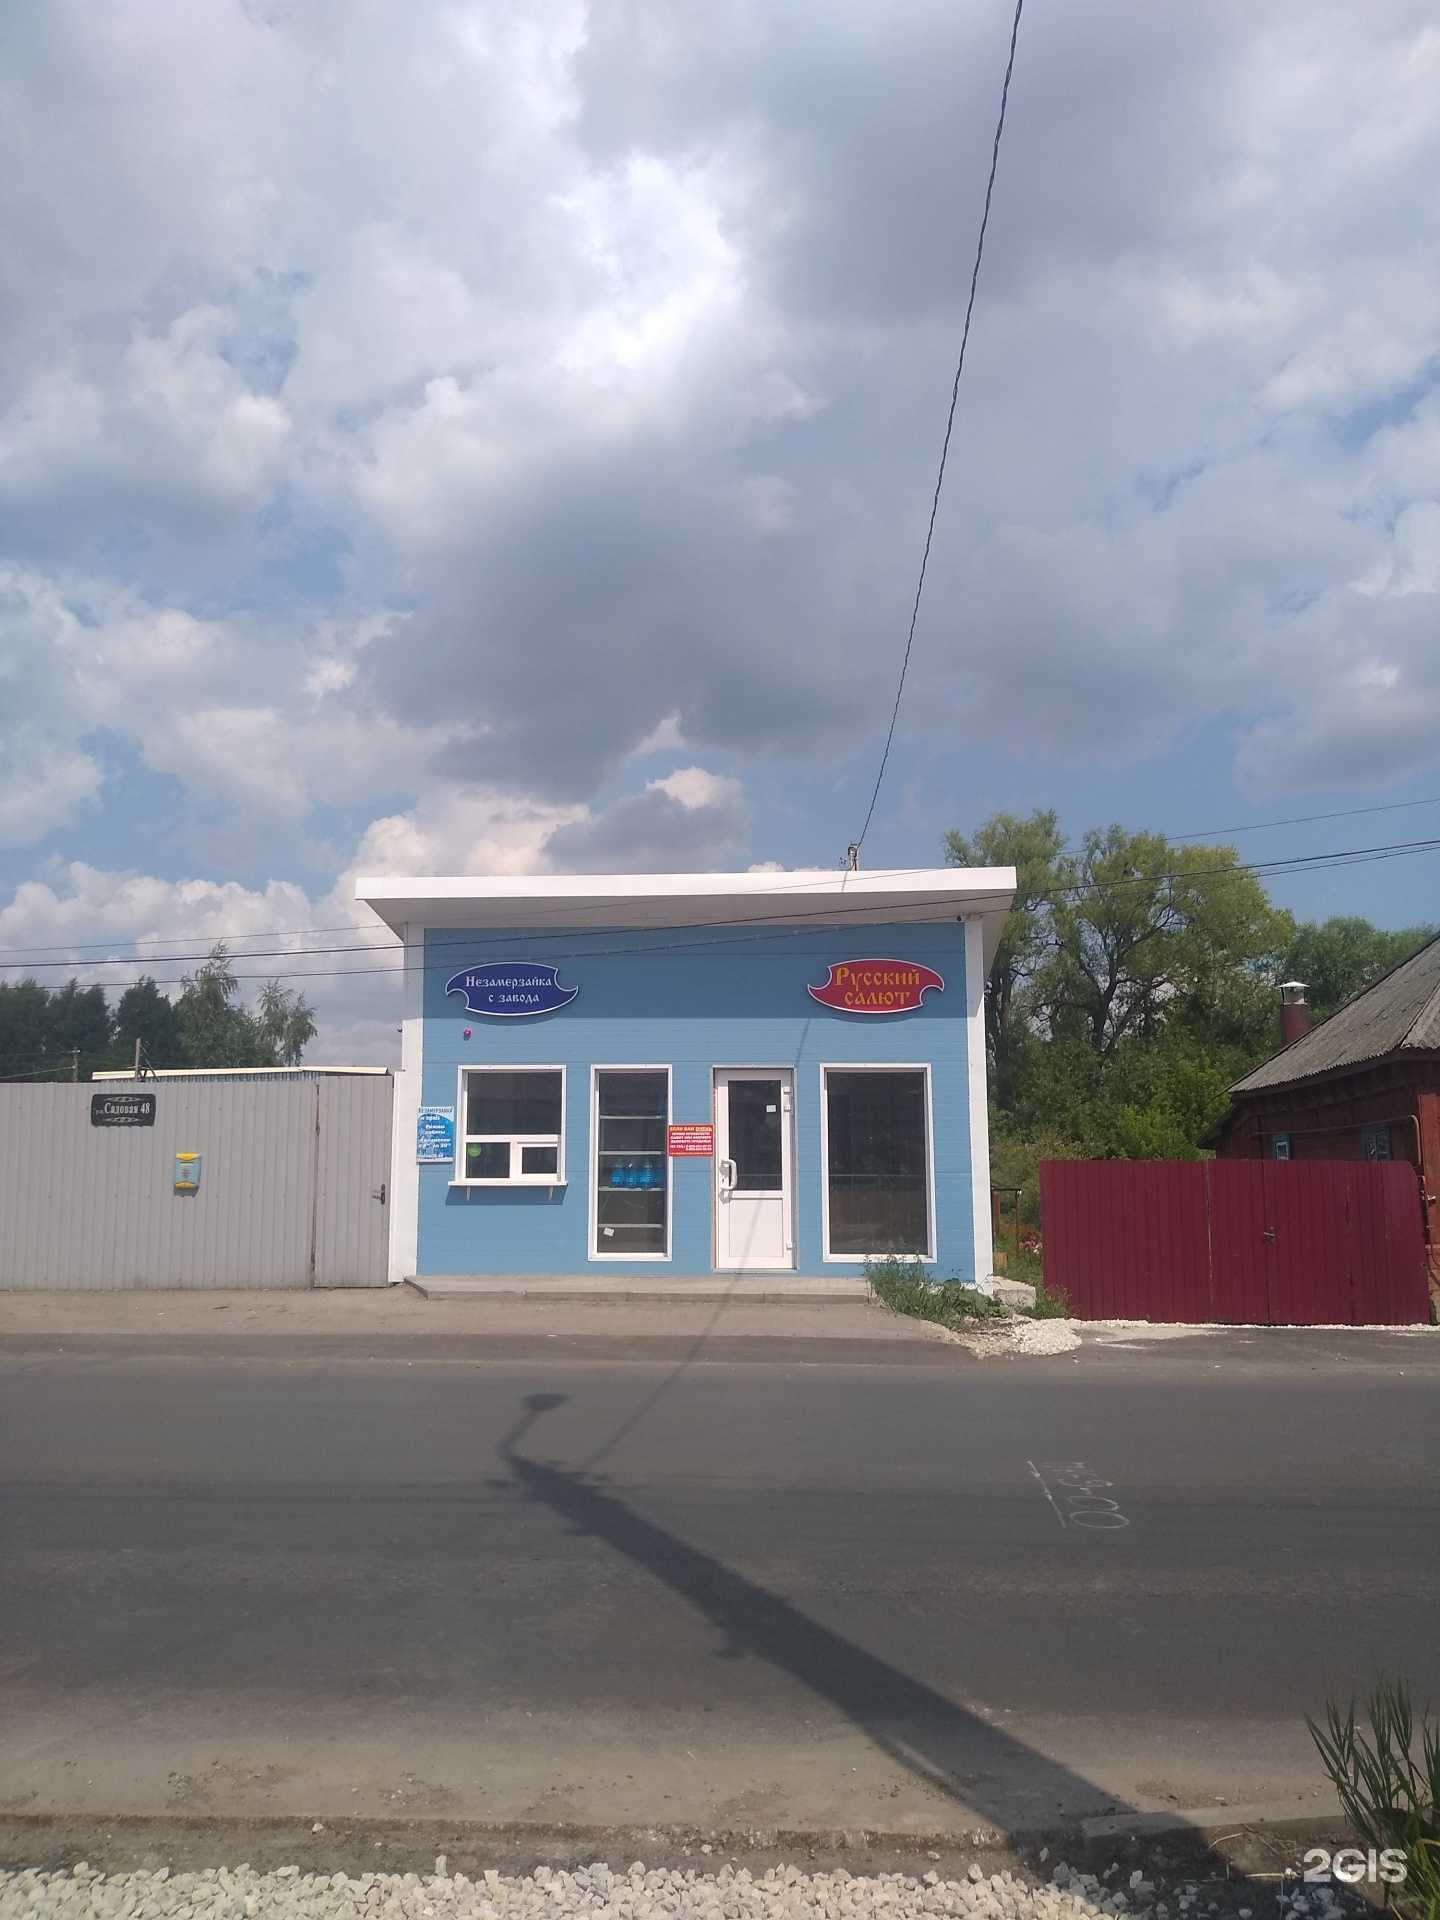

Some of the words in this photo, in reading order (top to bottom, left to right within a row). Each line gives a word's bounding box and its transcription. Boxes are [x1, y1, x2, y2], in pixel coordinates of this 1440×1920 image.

[465, 976, 552, 989] Незамерзайка
[835, 967, 920, 991] Русский
[488, 994, 494, 1002] с
[500, 993, 540, 1003] завода
[104, 1102, 139, 1115] Садовая
[140, 1102, 151, 1114] 48
